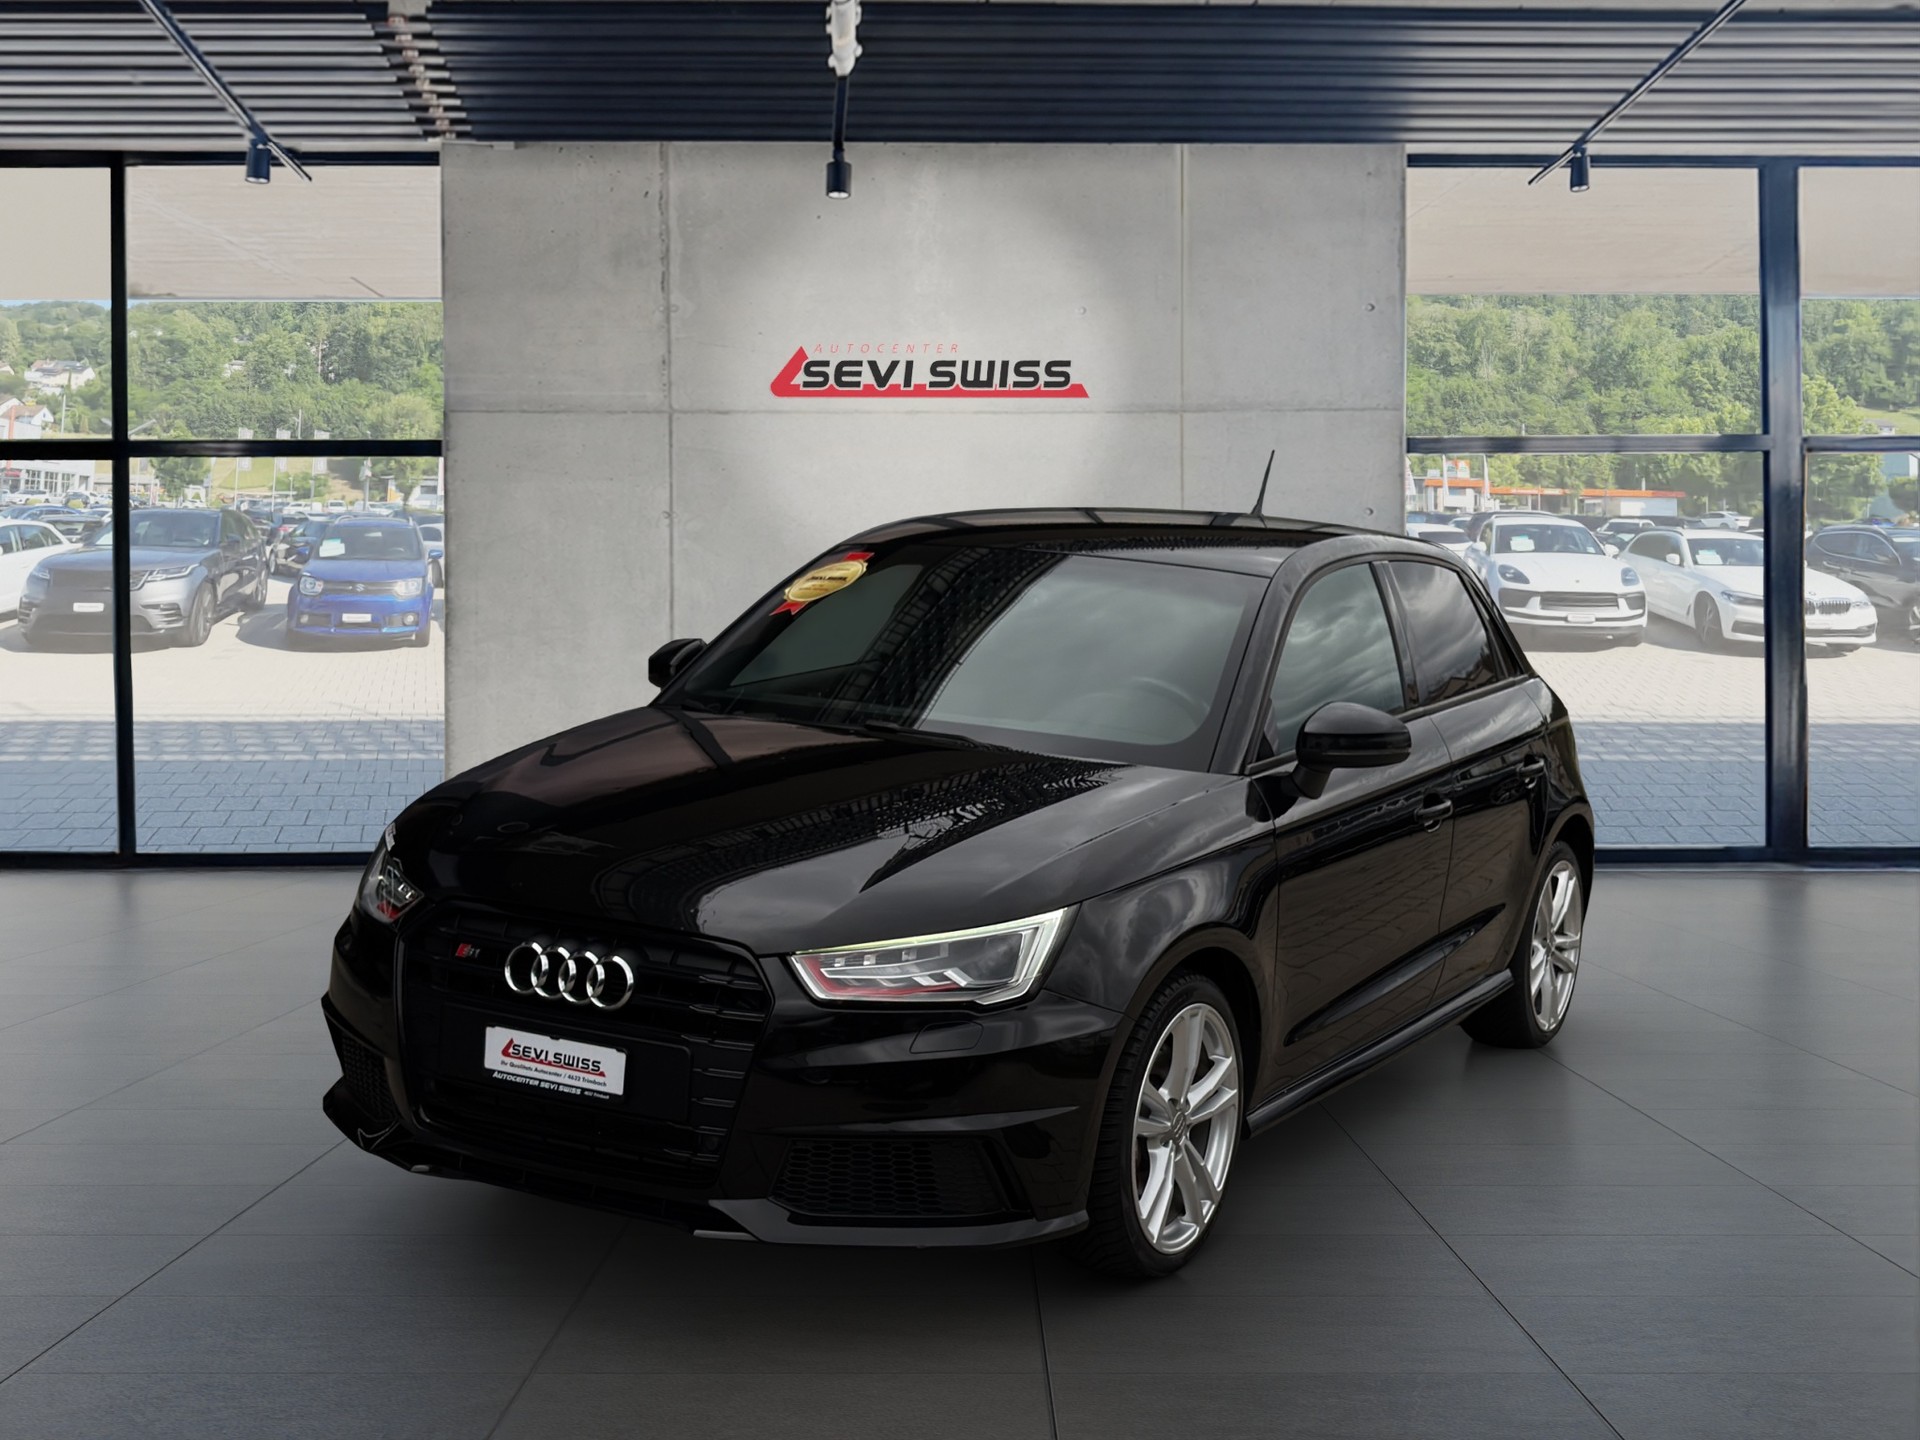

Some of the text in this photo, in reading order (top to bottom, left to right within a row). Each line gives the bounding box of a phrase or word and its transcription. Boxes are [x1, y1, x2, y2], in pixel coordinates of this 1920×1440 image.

[813, 343, 959, 354] AUTOCENTER
[802, 360, 1072, 388] SEVI SWISS
[511, 1043, 602, 1072] SEVI SWISS
